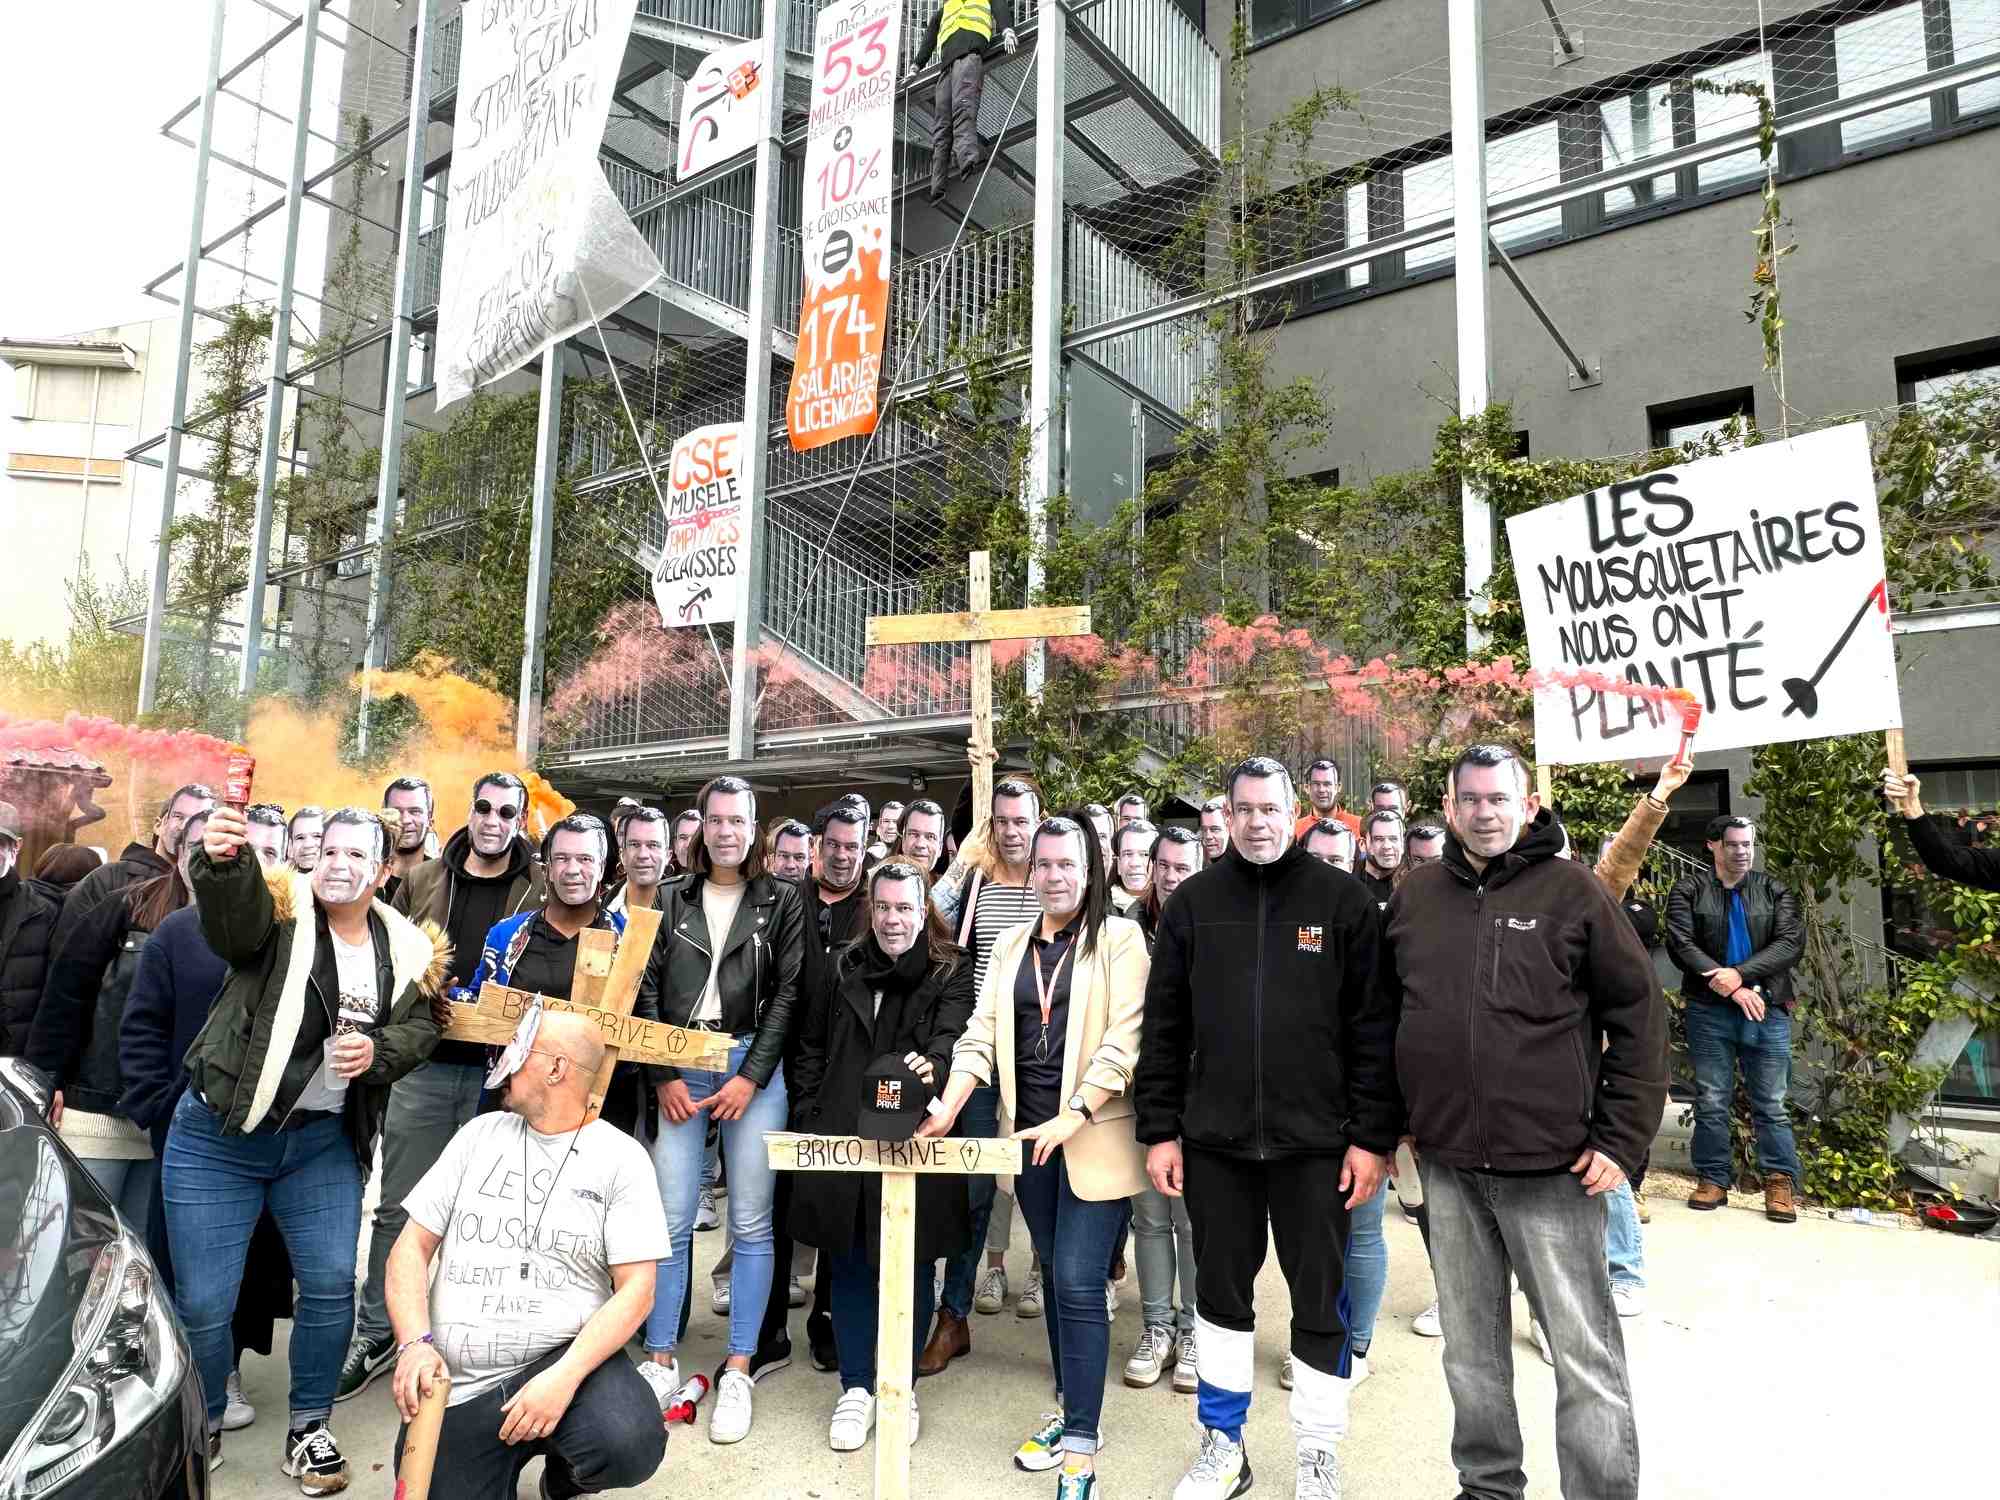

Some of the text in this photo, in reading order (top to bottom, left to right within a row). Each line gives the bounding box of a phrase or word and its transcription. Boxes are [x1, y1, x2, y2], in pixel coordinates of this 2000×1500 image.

[823, 16, 889, 95] 53
[811, 70, 892, 129] MILLIARDS
[817, 148, 882, 211] 10%
[817, 195, 889, 233] CROISSANCE
[803, 293, 876, 369] 174
[671, 433, 738, 491] CSE
[1585, 473, 1694, 553] LES
[1559, 587, 1745, 667] NOUS ONT
[477, 1153, 553, 1206] LES
[795, 1138, 863, 1168] BRICO
